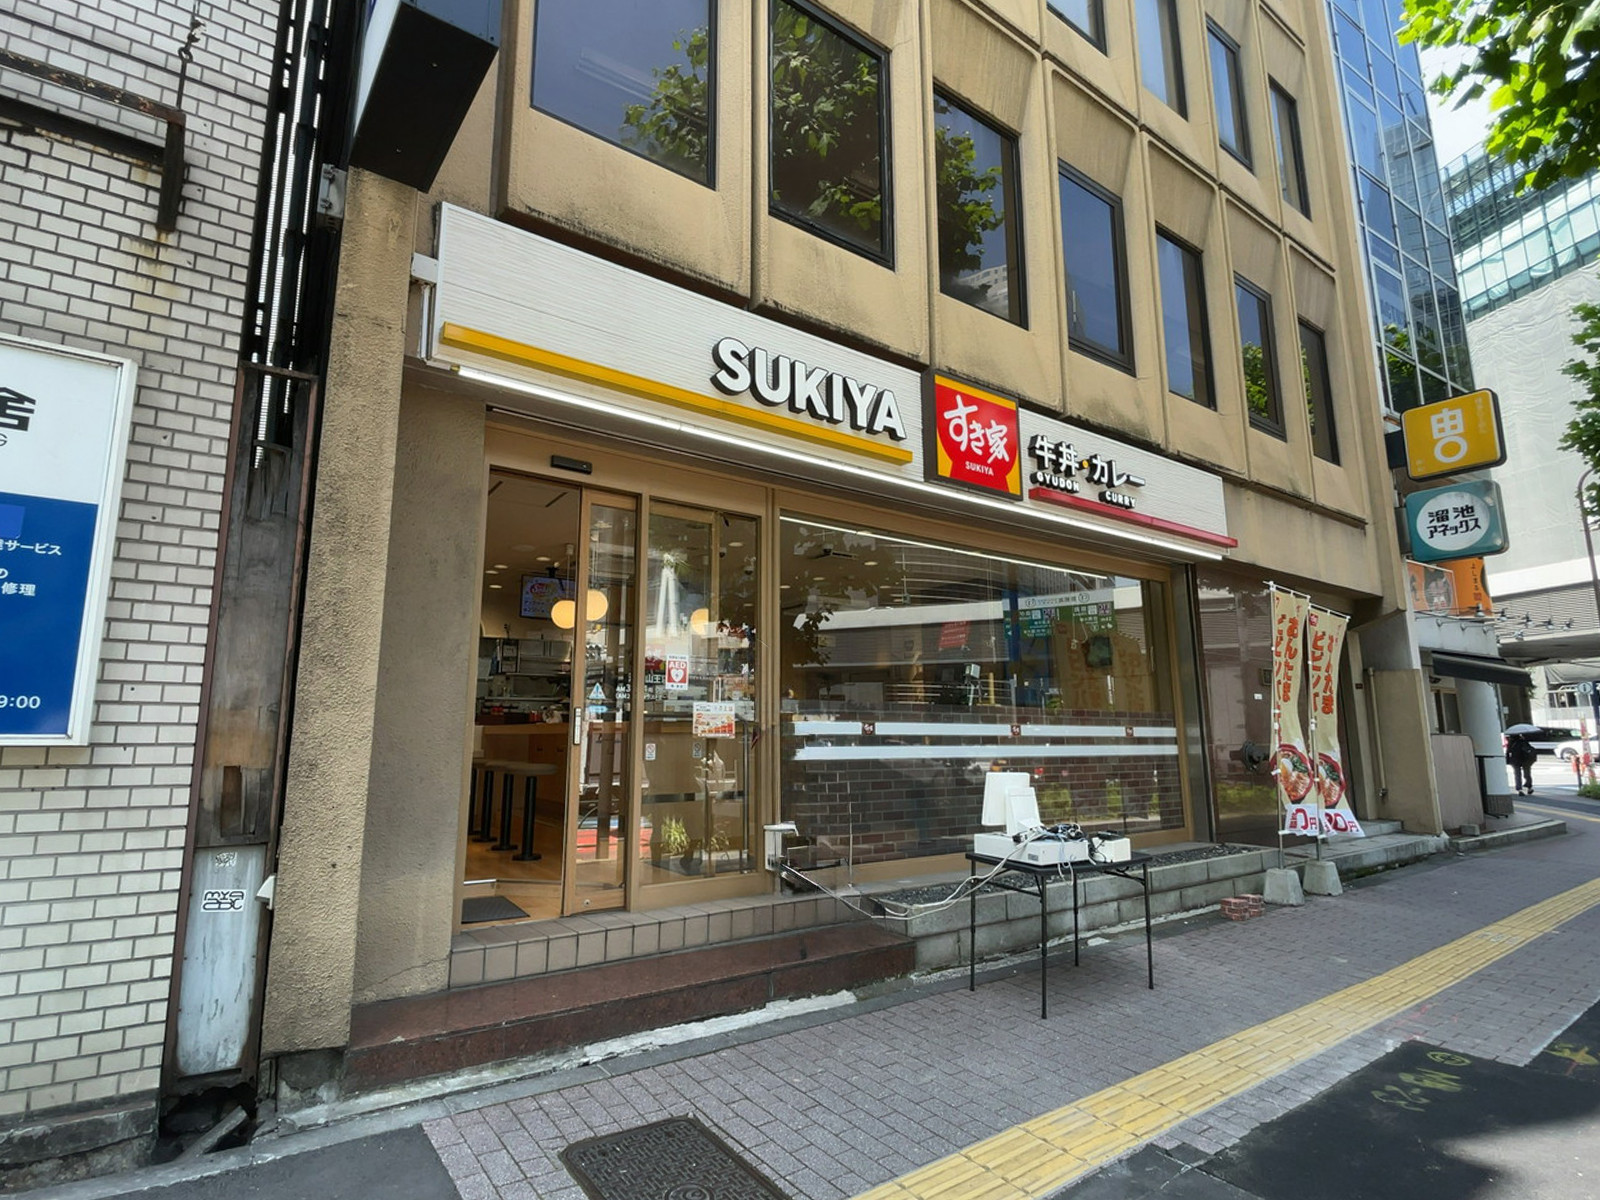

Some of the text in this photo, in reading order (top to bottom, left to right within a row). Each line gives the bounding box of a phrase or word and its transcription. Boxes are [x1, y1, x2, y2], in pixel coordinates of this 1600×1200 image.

[712, 337, 907, 440] SUKIYA
[944, 394, 1010, 464] すき家
[965, 460, 994, 476] SUKIYA
[1032, 471, 1080, 494] GYUDON
[1102, 490, 1137, 509] CURRY
[1428, 505, 1475, 524] 溜池
[1427, 518, 1481, 539] アネックス
[1, 582, 36, 596] 修理
[668, 661, 687, 669] AED
